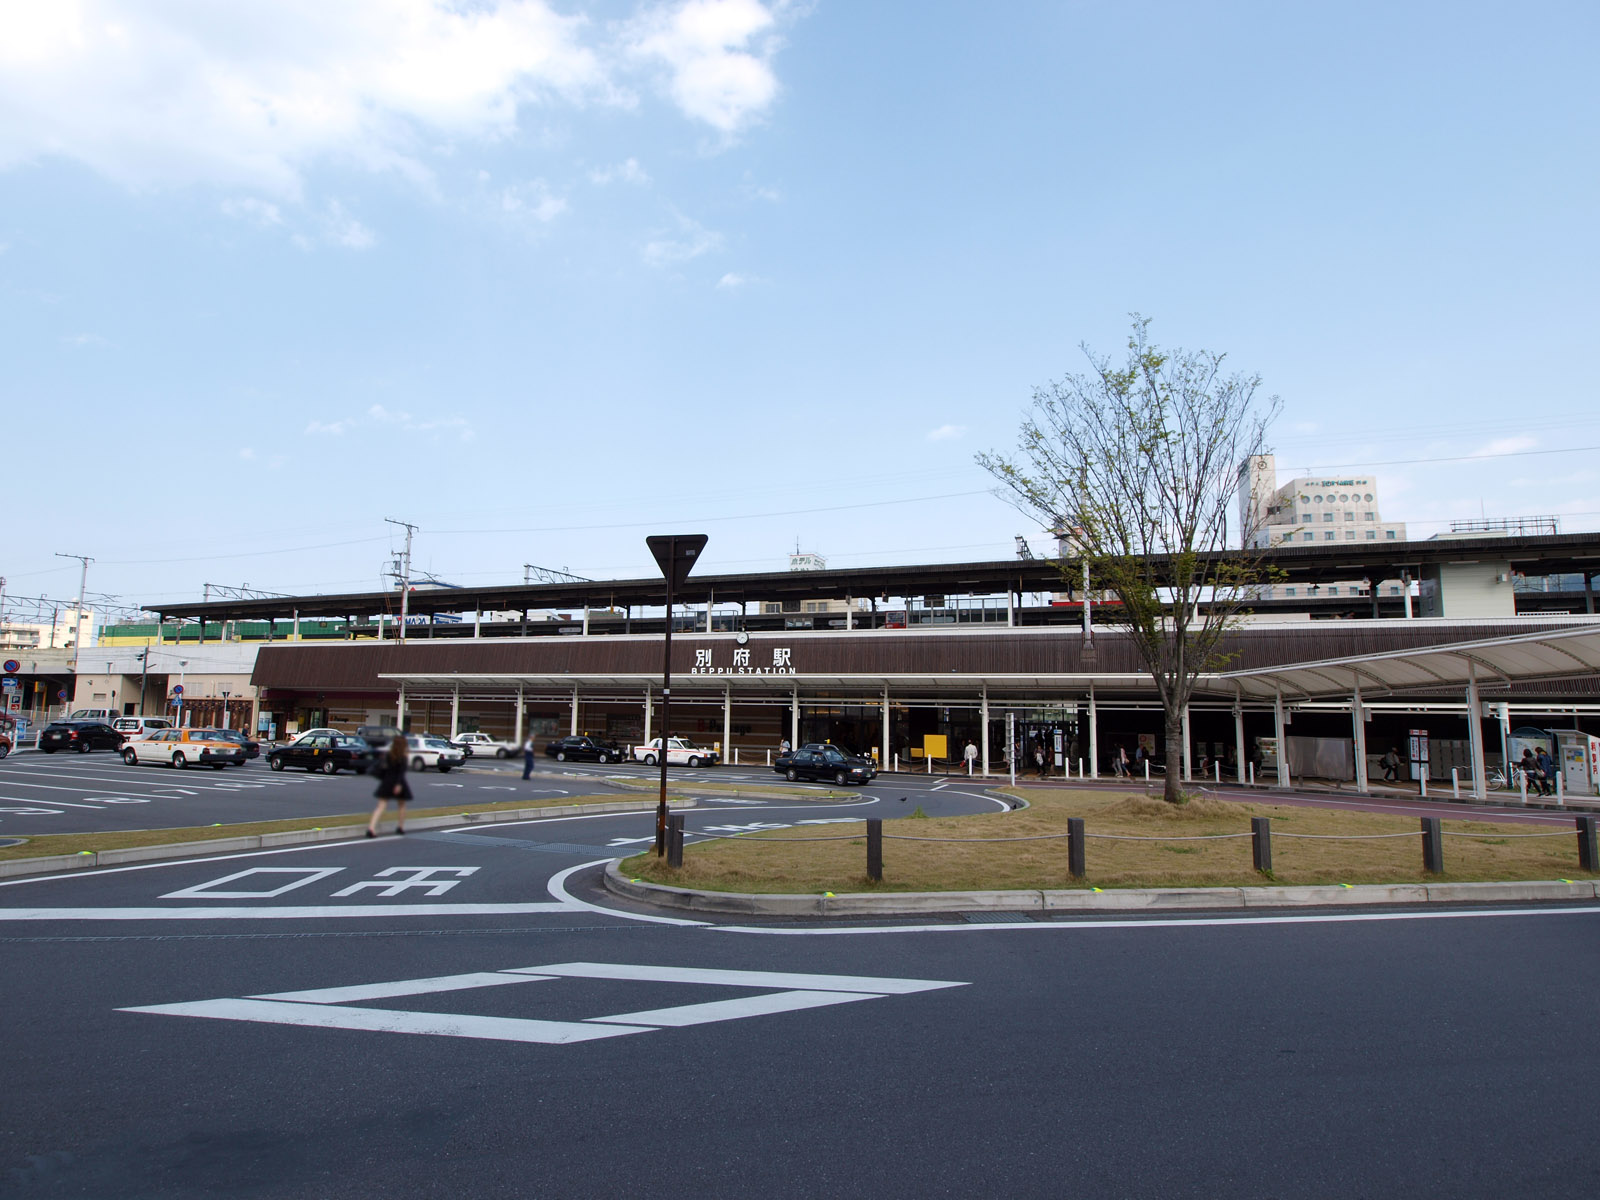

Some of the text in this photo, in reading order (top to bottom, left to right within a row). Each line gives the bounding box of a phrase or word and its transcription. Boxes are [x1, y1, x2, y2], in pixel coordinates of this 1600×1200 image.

[791, 557, 811, 565] ホテル
[396, 617, 427, 625] YMADA
[695, 648, 791, 667] 別府駅
[691, 667, 796, 675] BEPPU STATION
[157, 866, 482, 898] 出口
